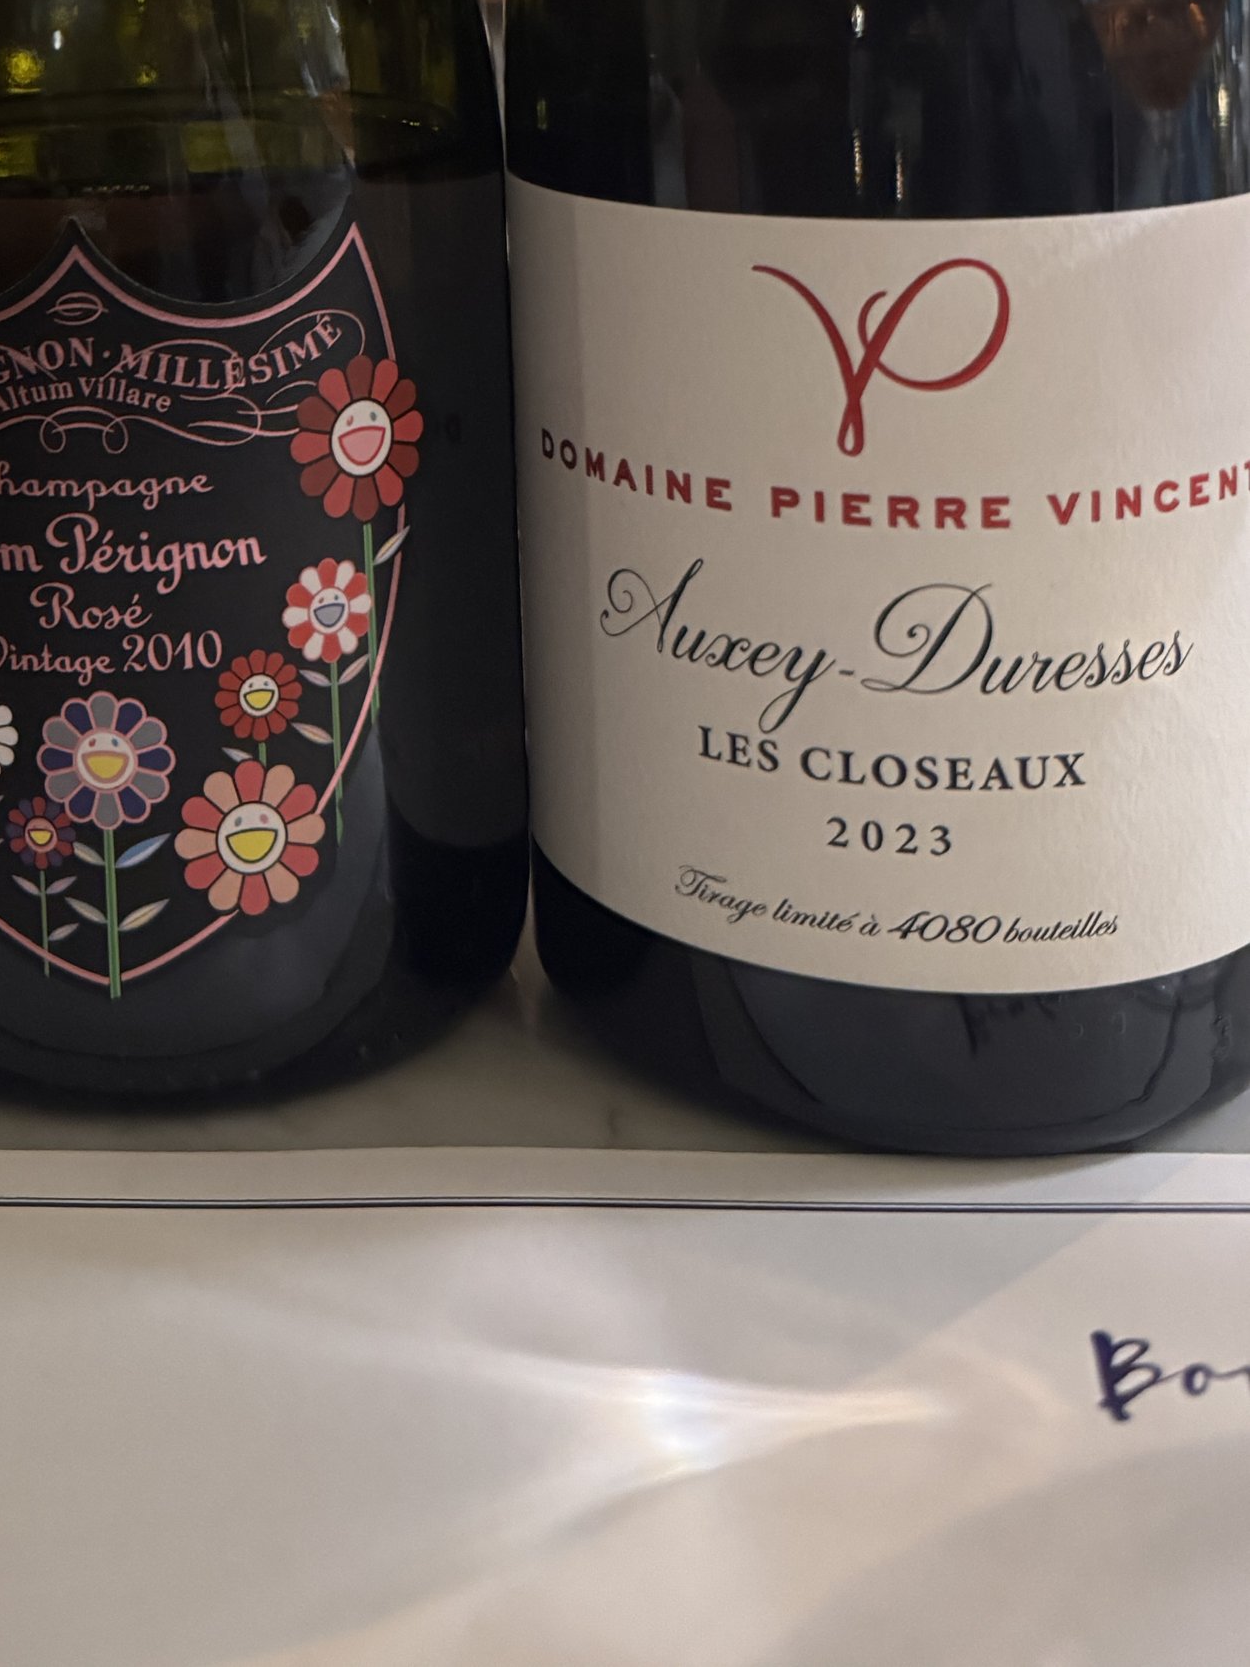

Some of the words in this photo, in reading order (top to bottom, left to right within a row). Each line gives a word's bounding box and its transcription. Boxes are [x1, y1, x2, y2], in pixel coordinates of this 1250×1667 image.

[78, 376, 172, 413] Villare
[540, 428, 734, 512] DOMAINE
[770, 487, 1012, 530] PIERRE
[45, 512, 267, 595] Pérignon
[29, 582, 152, 630] Rosé
[122, 629, 223, 673] 2010
[599, 558, 1194, 733] Auxey-Duresses
[697, 726, 780, 772] LES
[801, 747, 1087, 791] CLOSEAUX
[825, 818, 953, 857] 2023
[674, 865, 768, 924] Tirage
[772, 897, 861, 935] limité
[858, 914, 881, 936] à
[888, 911, 1002, 944] 4080
[1002, 910, 1119, 944] bouteilles
[1090, 1330, 1250, 1422] Bo
